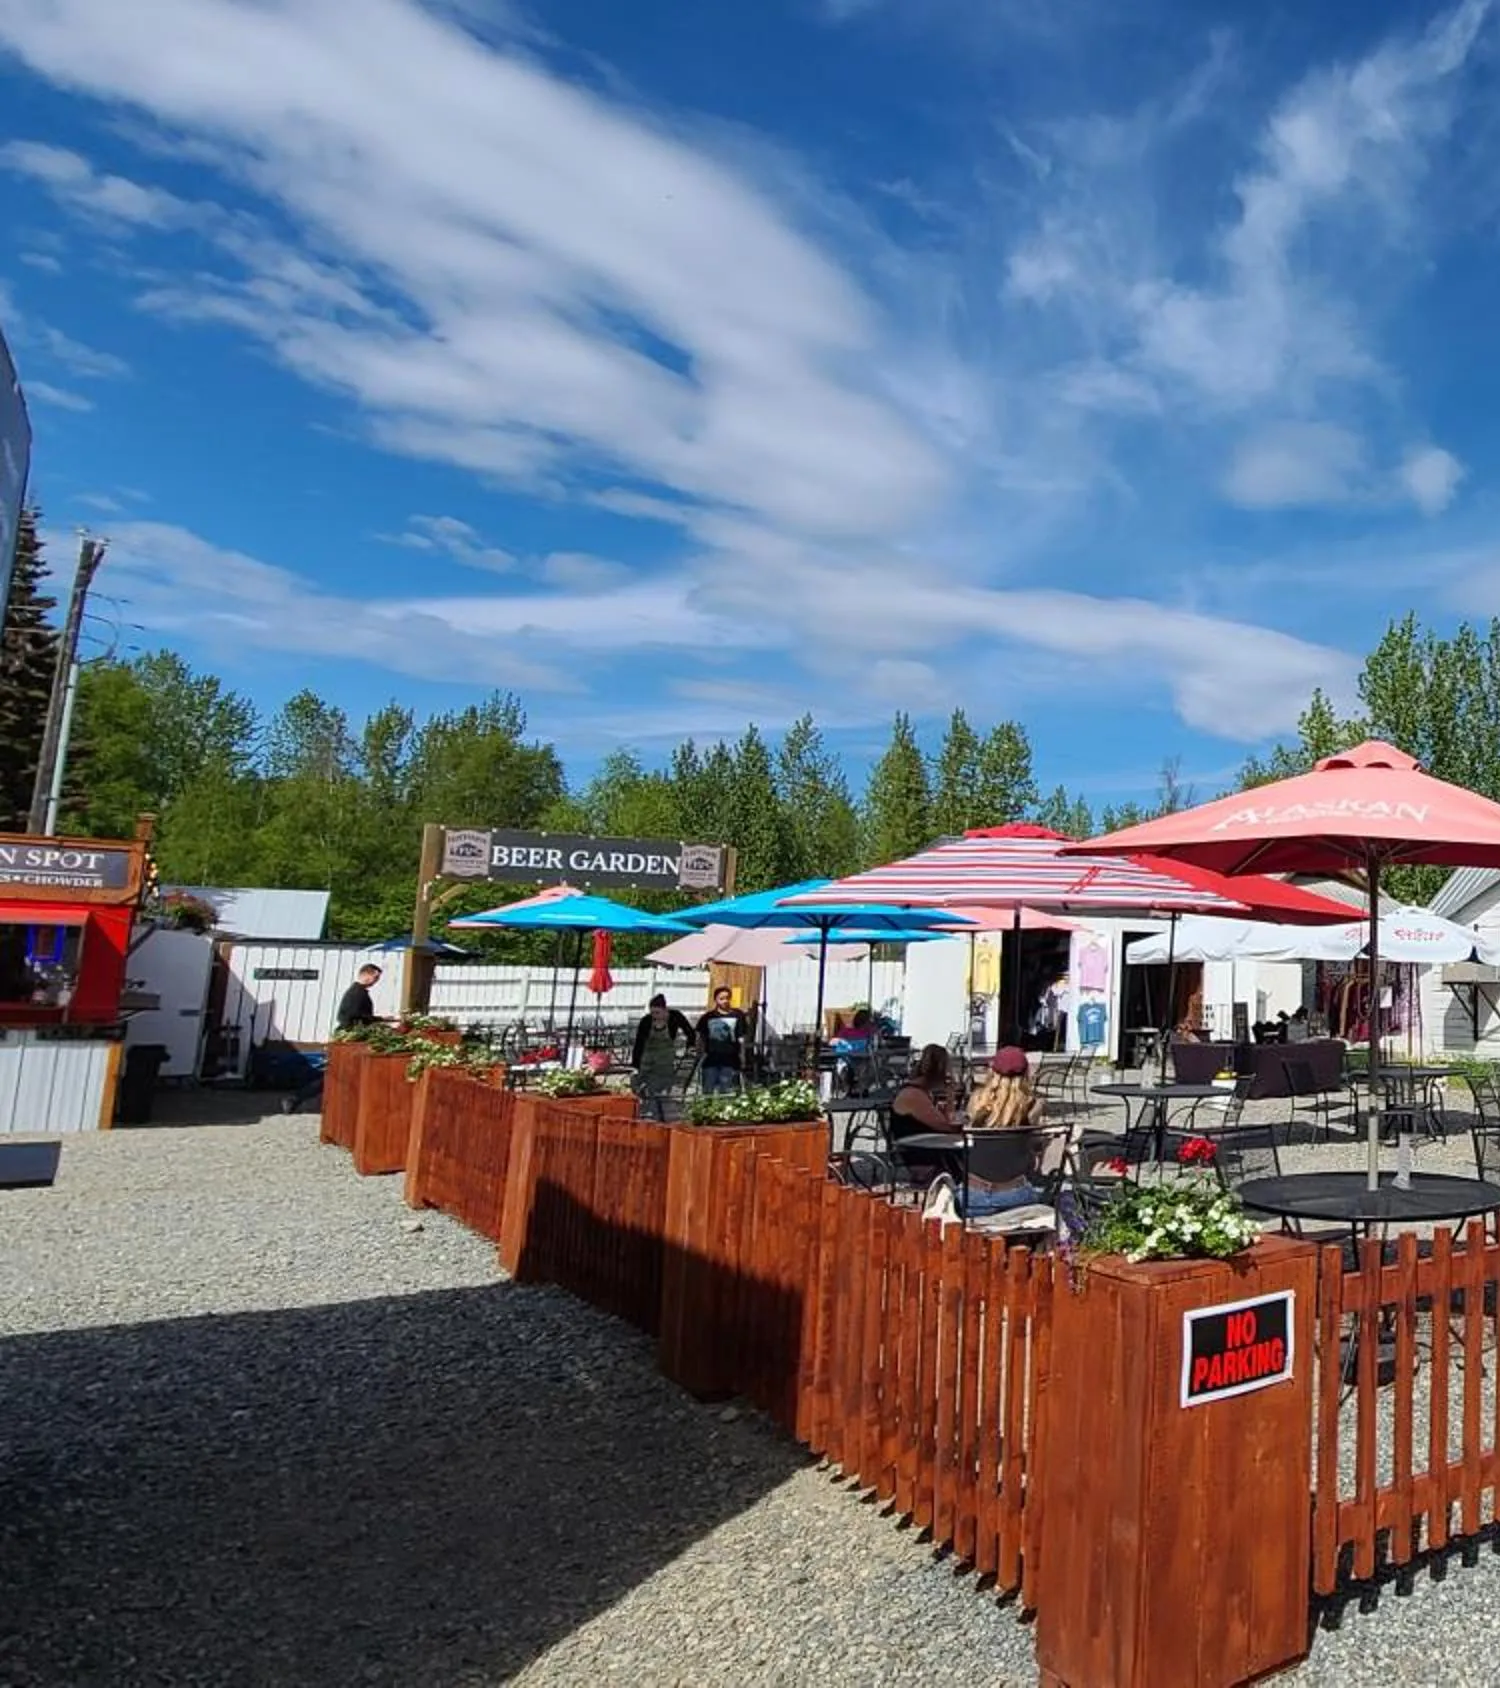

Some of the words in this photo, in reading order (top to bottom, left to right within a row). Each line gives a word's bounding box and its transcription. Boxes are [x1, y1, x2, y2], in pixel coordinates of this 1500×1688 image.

[1212, 799, 1429, 832] ALASKAN
[25, 848, 105, 869] SPOT
[491, 845, 563, 869] BEER
[569, 850, 681, 876] GARDEN
[1227, 1310, 1257, 1349] NO
[1193, 1336, 1284, 1393] PARKING
